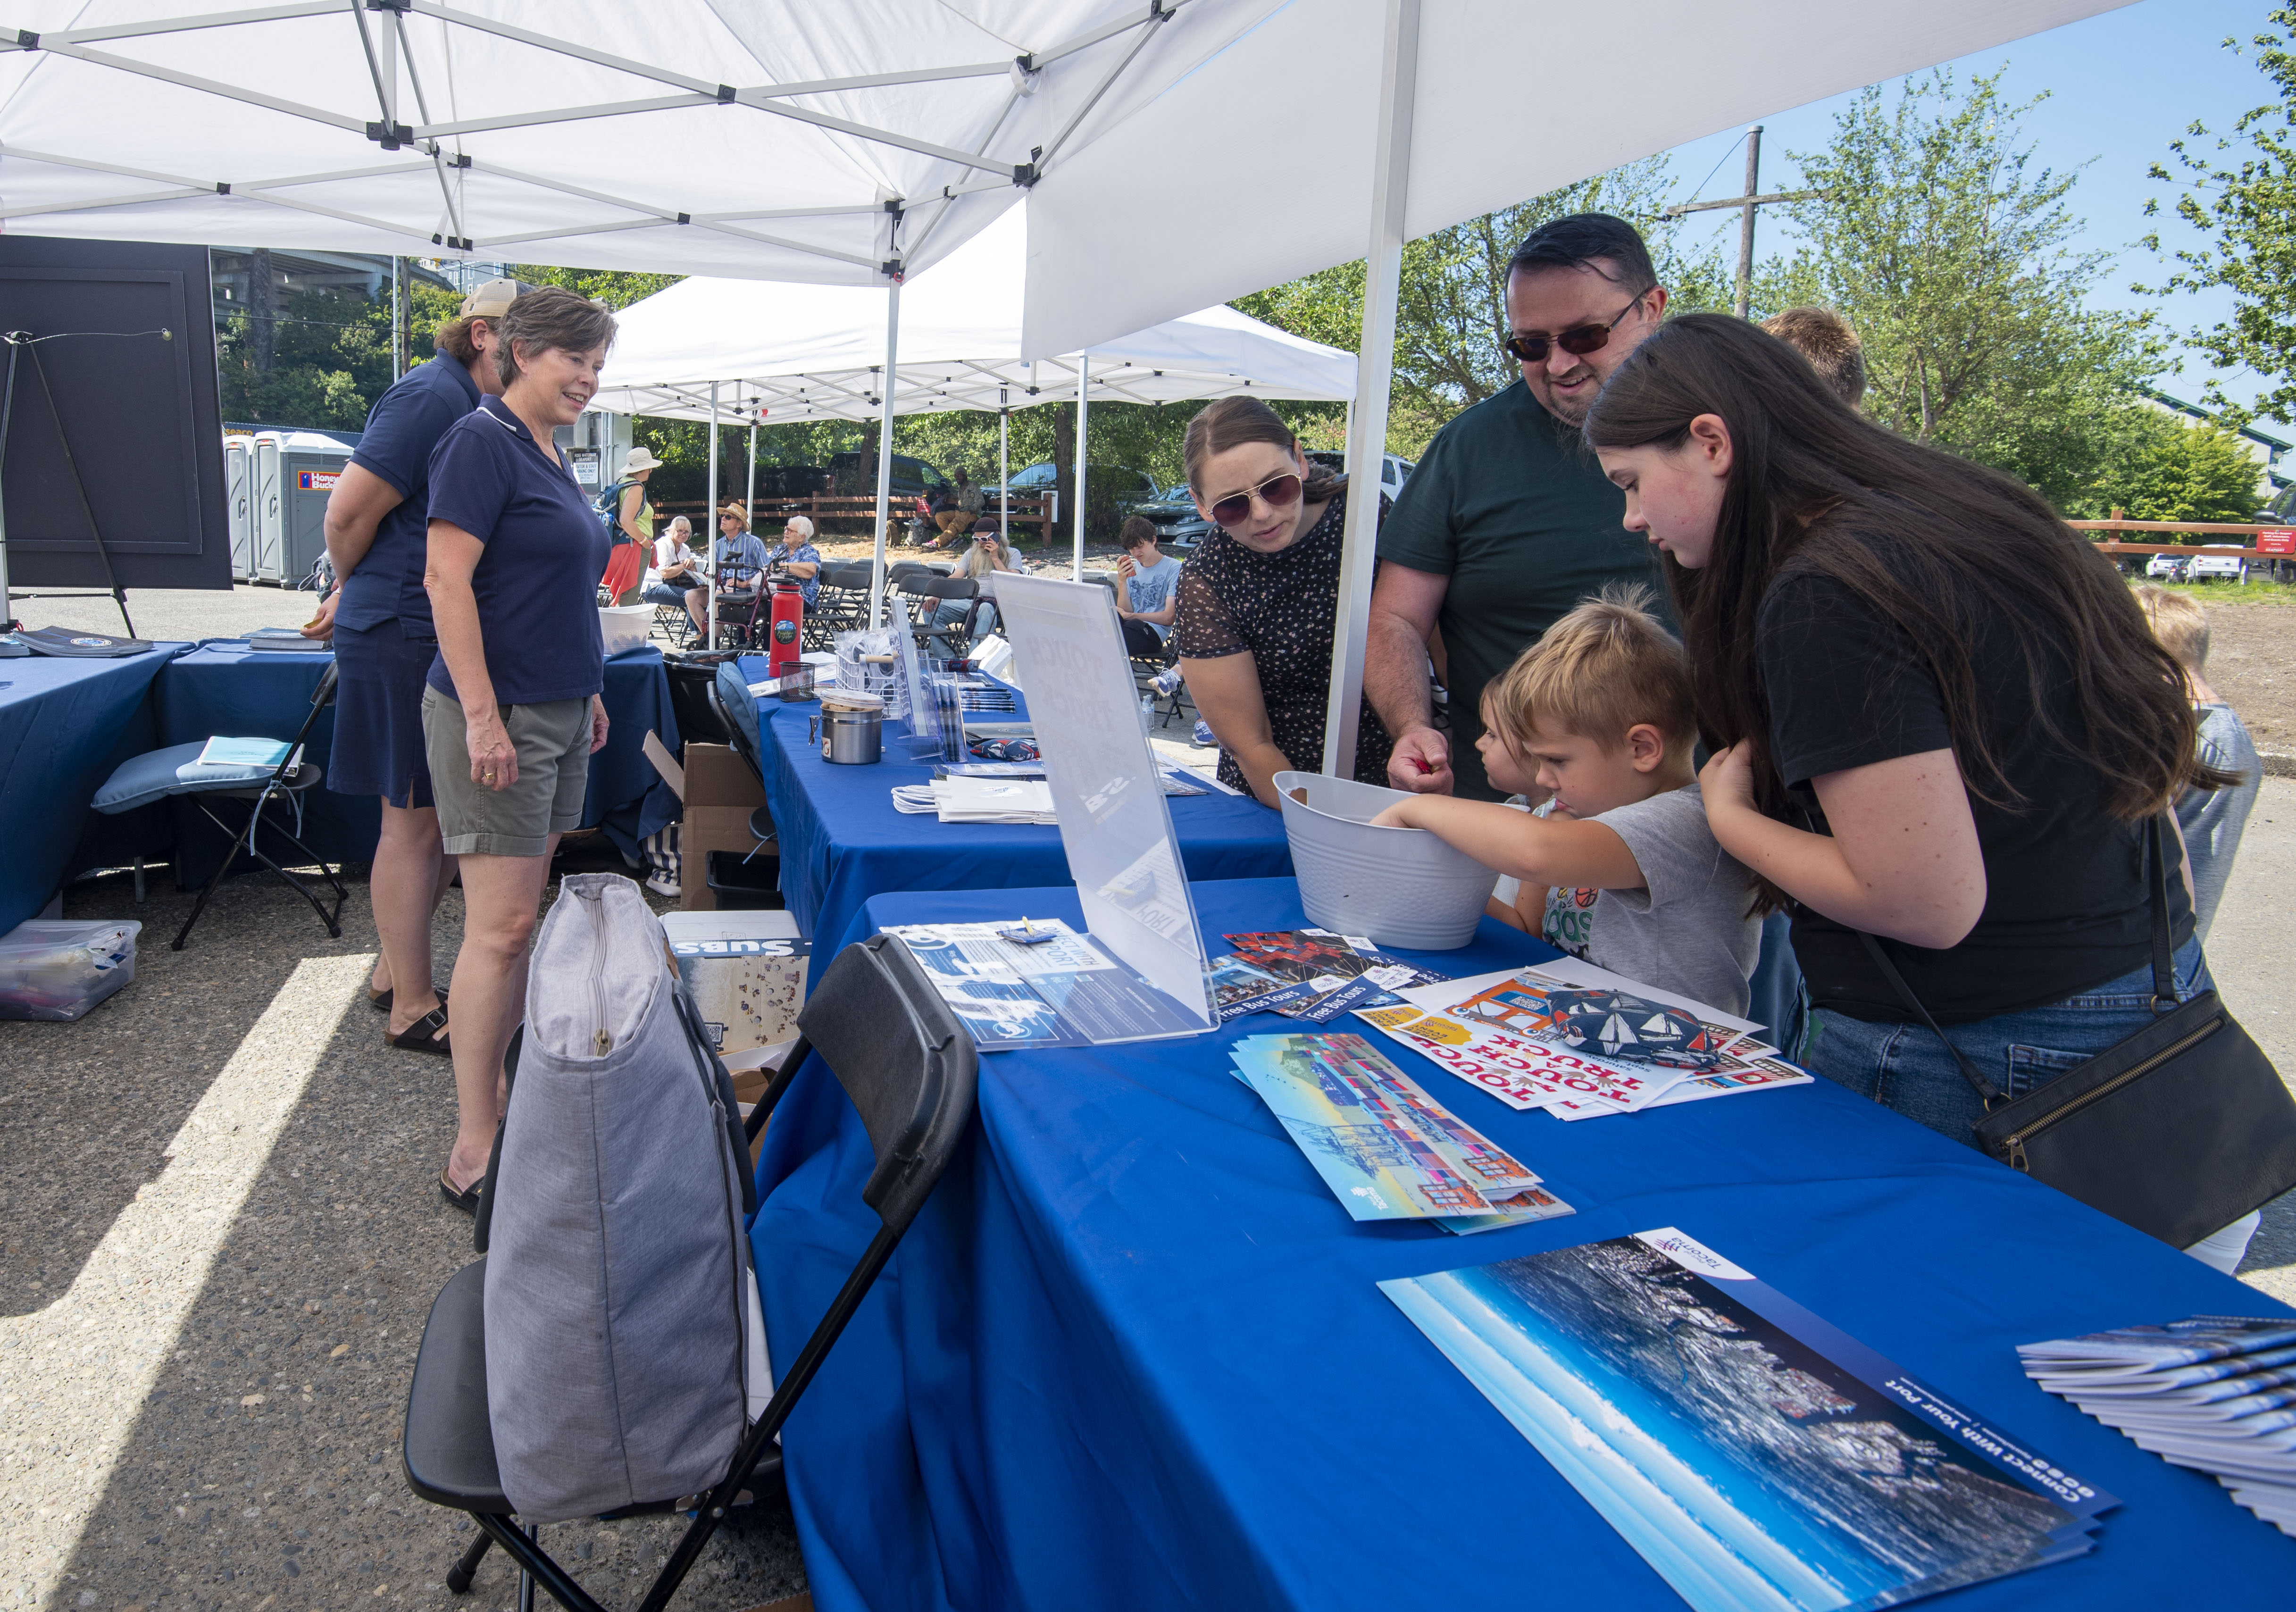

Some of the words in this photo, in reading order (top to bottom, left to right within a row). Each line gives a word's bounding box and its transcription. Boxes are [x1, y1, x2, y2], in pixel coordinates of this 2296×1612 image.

[311, 473, 340, 483] Honey
[1039, 945, 1081, 967] PORT
[1215, 1005, 1247, 1017] Free
[1244, 999, 1270, 1010] Bus
[1267, 990, 1300, 1003] Tours
[1306, 1005, 1334, 1019] Free
[1327, 996, 1348, 1010] Bus
[1339, 986, 1366, 1001] Tours
[1467, 1044, 1631, 1103] TOUCH
[1488, 1034, 1645, 1090] TRUCK
[1671, 1237, 1722, 1269] Tacoma
[1885, 1380, 1923, 1404] Port
[1921, 1403, 1960, 1430] Your
[1961, 1427, 2004, 1456] With
[2003, 1453, 2080, 1503] Connect
